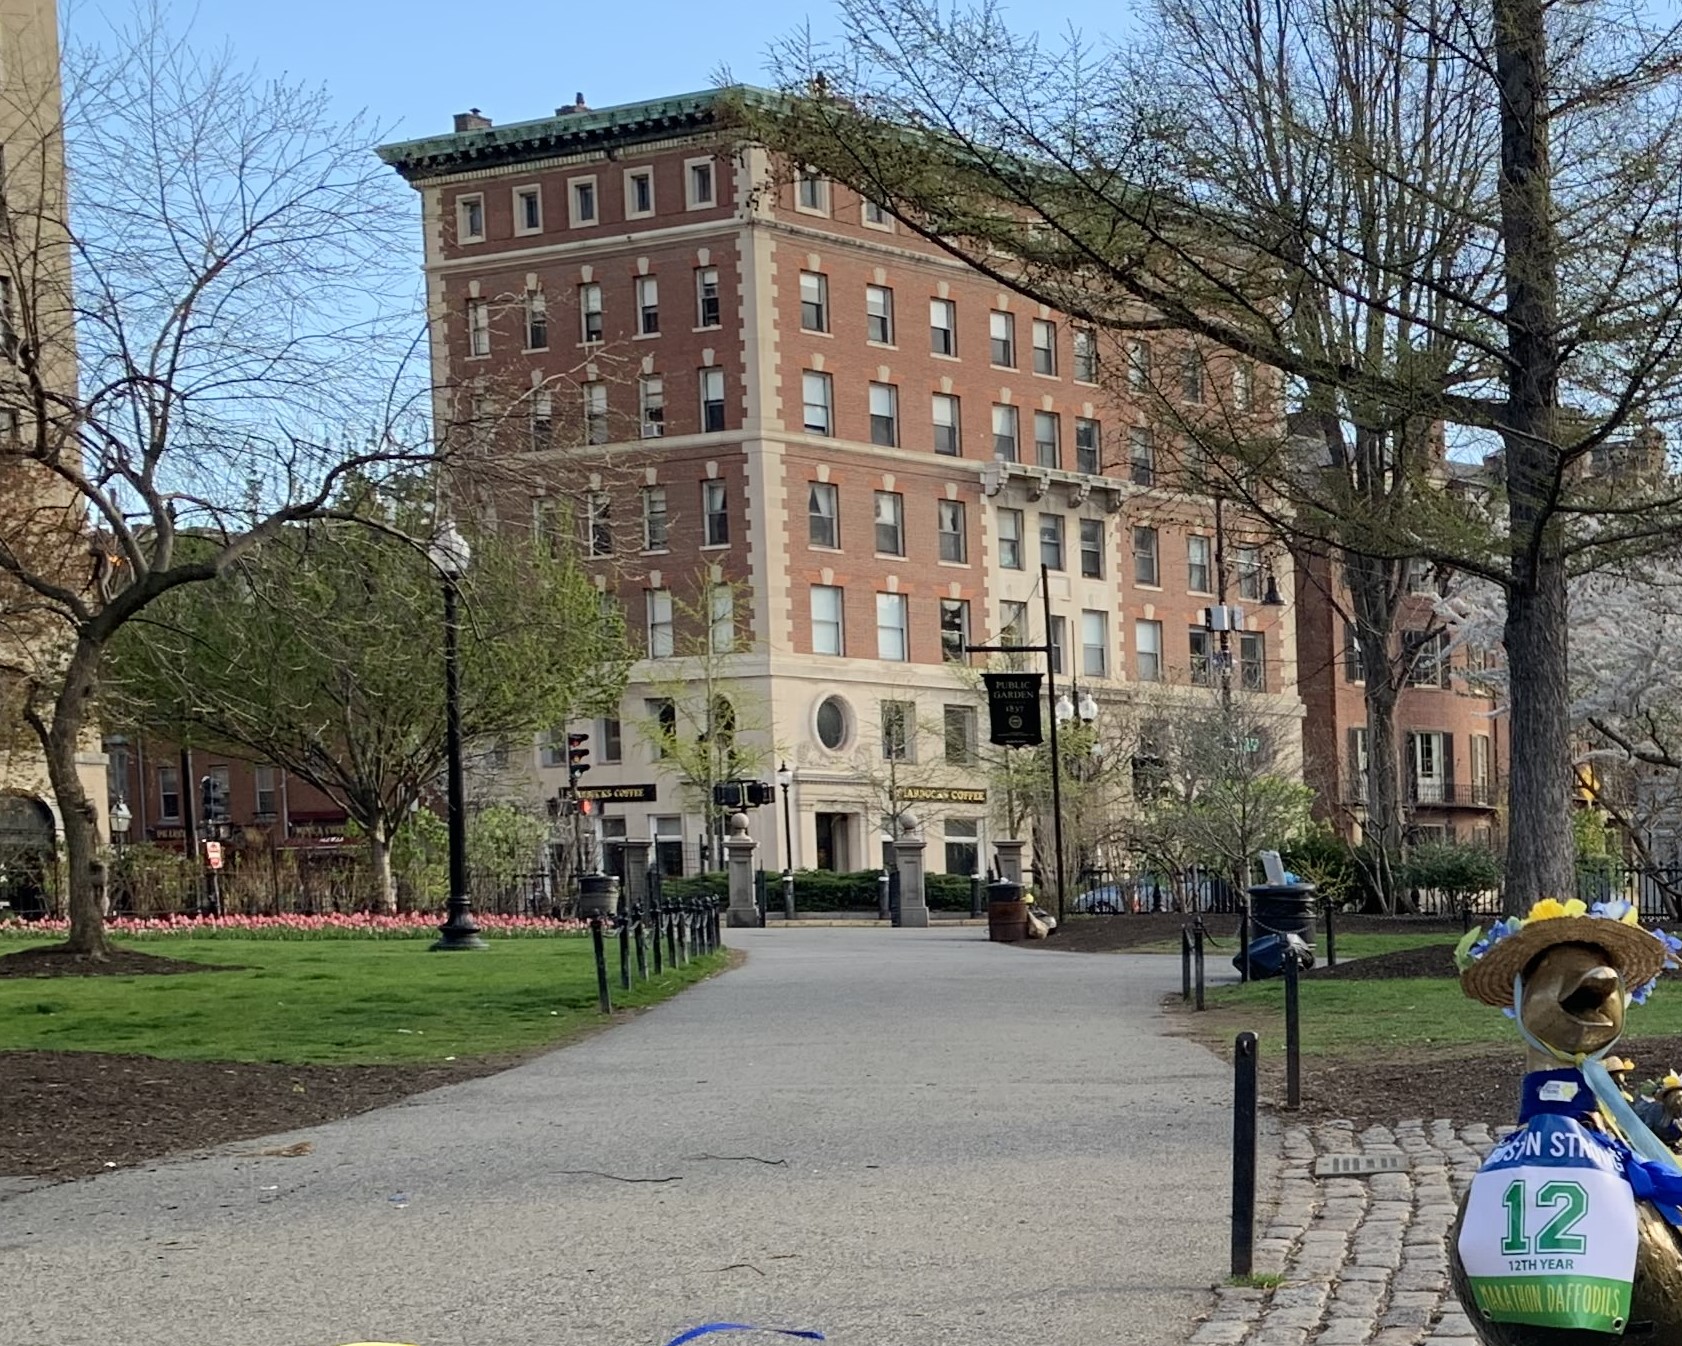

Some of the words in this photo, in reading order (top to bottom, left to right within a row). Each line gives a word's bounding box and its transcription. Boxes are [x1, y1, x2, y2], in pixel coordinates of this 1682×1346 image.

[995, 681, 1031, 689] PUBLIC
[993, 690, 1034, 699] GARDEN
[950, 790, 985, 800] COFFEE
[1501, 1179, 1589, 1256] 12
[1508, 1260, 1537, 1271] 12TH
[1539, 1259, 1574, 1270] YEAR
[1479, 1283, 1543, 1313] MARATHON
[1547, 1282, 1620, 1318] DAFFODILS
